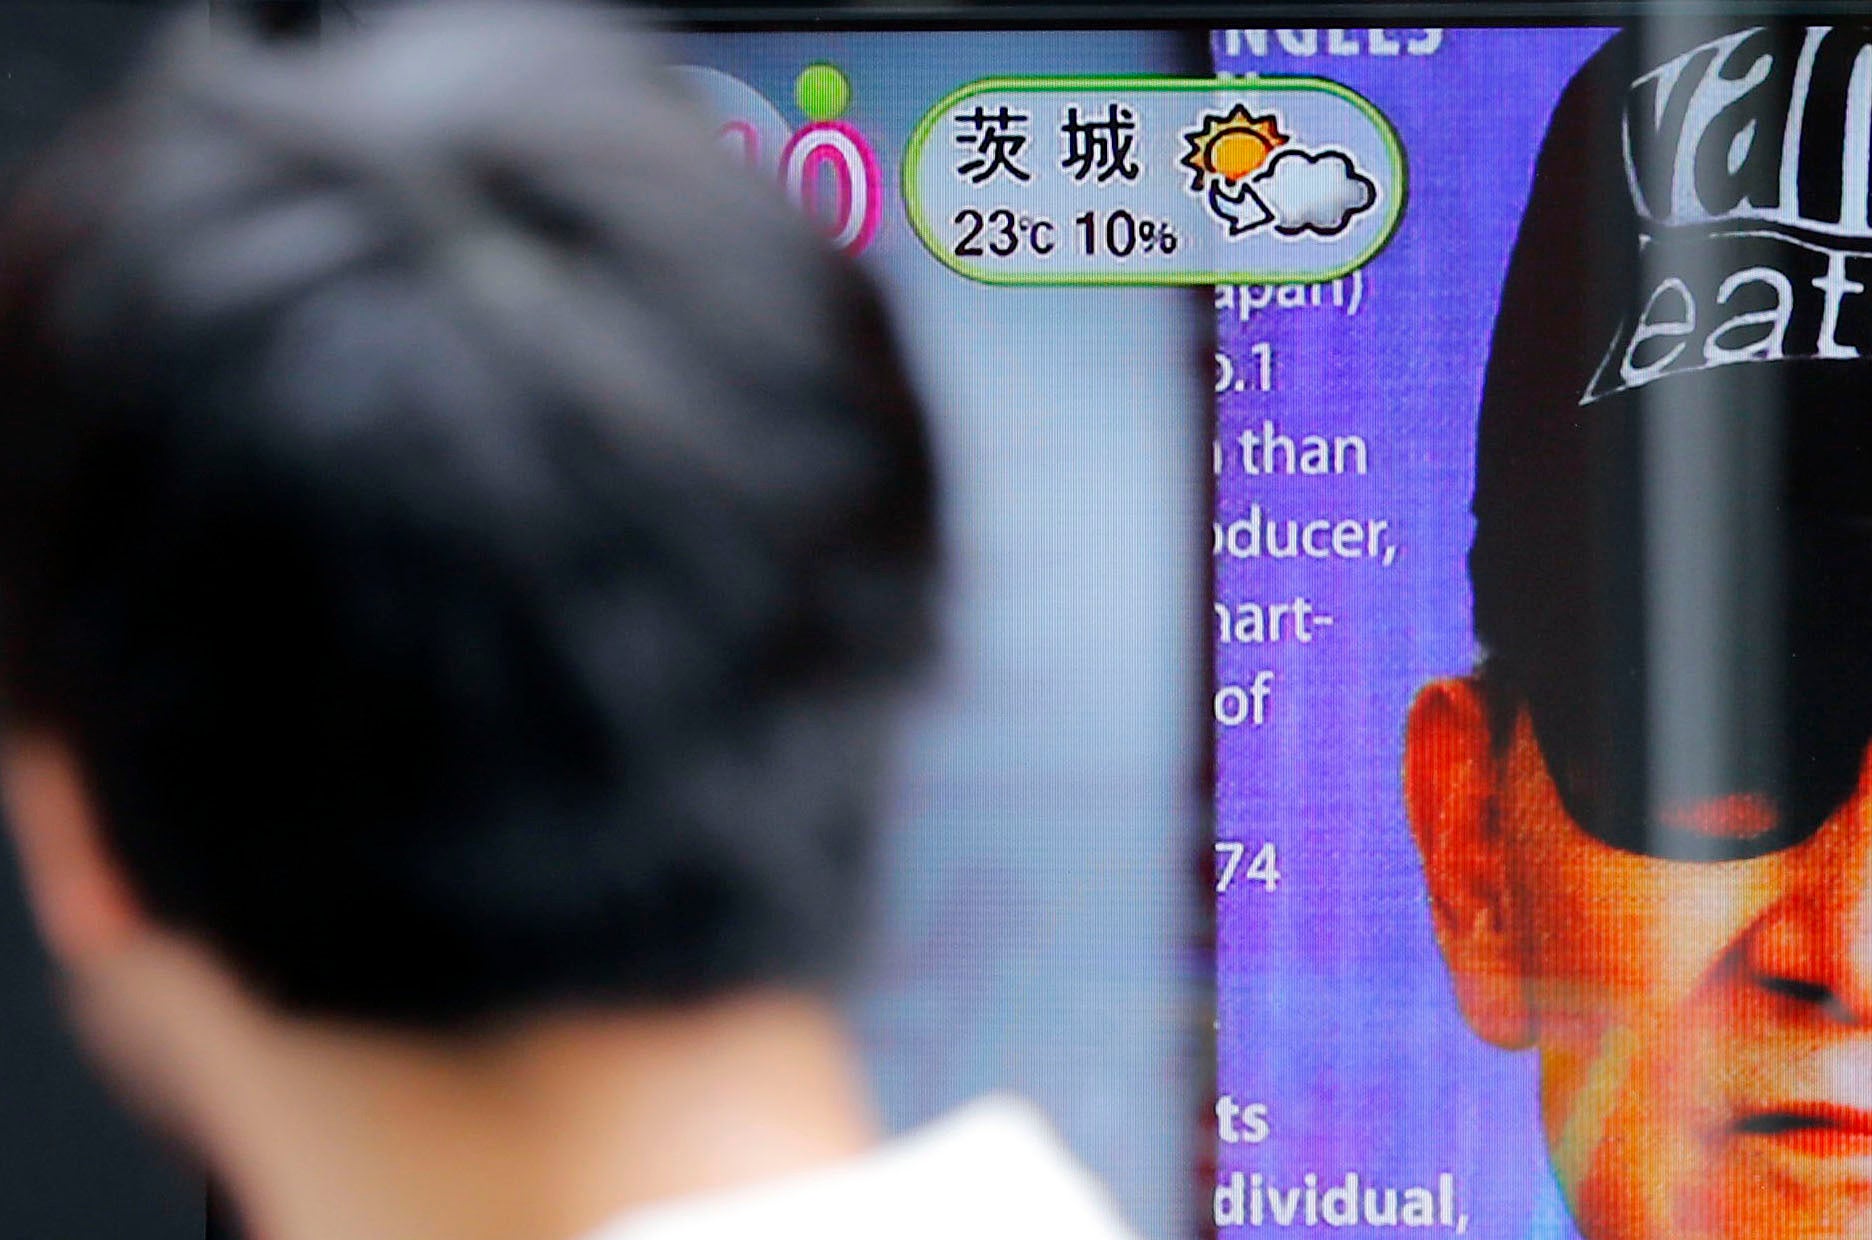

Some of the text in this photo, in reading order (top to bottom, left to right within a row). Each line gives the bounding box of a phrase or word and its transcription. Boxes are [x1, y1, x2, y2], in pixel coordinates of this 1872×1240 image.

[955, 104, 1140, 184] 茨城
[1076, 209, 1178, 257] 10%
[1238, 420, 1368, 476] than
[1213, 670, 1275, 726] of
[1214, 842, 1281, 893] 74
[1214, 1095, 1270, 1143] ts
[1214, 1172, 1469, 1235] dividual,
